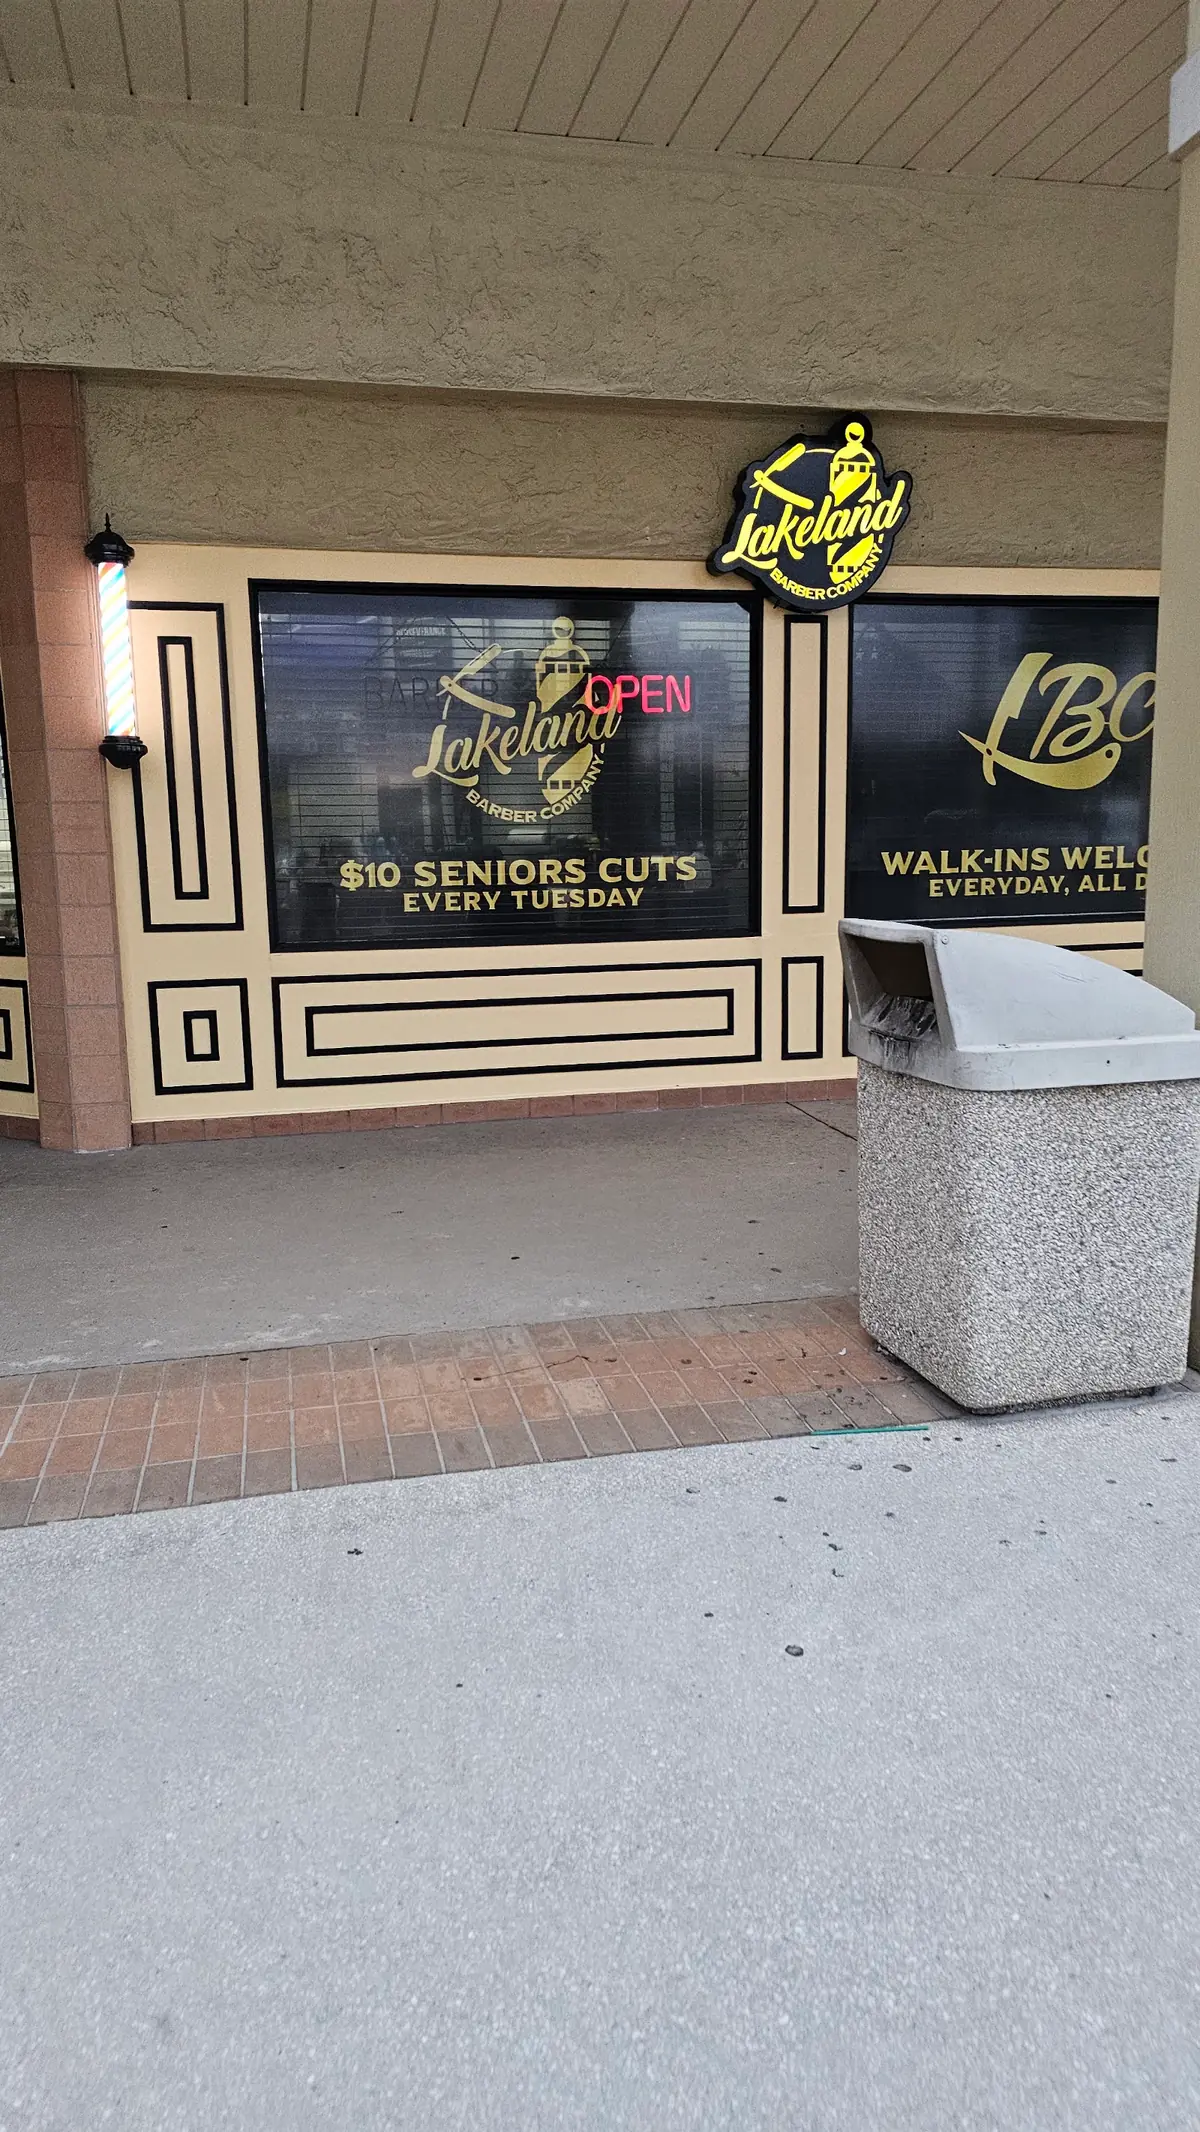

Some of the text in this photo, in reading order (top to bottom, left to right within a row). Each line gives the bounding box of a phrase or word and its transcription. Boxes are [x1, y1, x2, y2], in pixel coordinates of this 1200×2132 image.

[722, 480, 905, 569] Lakeland
[769, 542, 883, 600] BARBER COMPANY
[584, 674, 692, 715] OPEN
[412, 684, 622, 786] Lakeland
[465, 757, 605, 823] BARBER COMPANY
[339, 855, 698, 891] $10 SENIORS CUTS
[880, 847, 1050, 875] WALK-INS
[403, 887, 644, 912] EVERY TUESDAY
[928, 875, 1070, 897] EVERYDAY,
[1078, 873, 1126, 892] ALL
